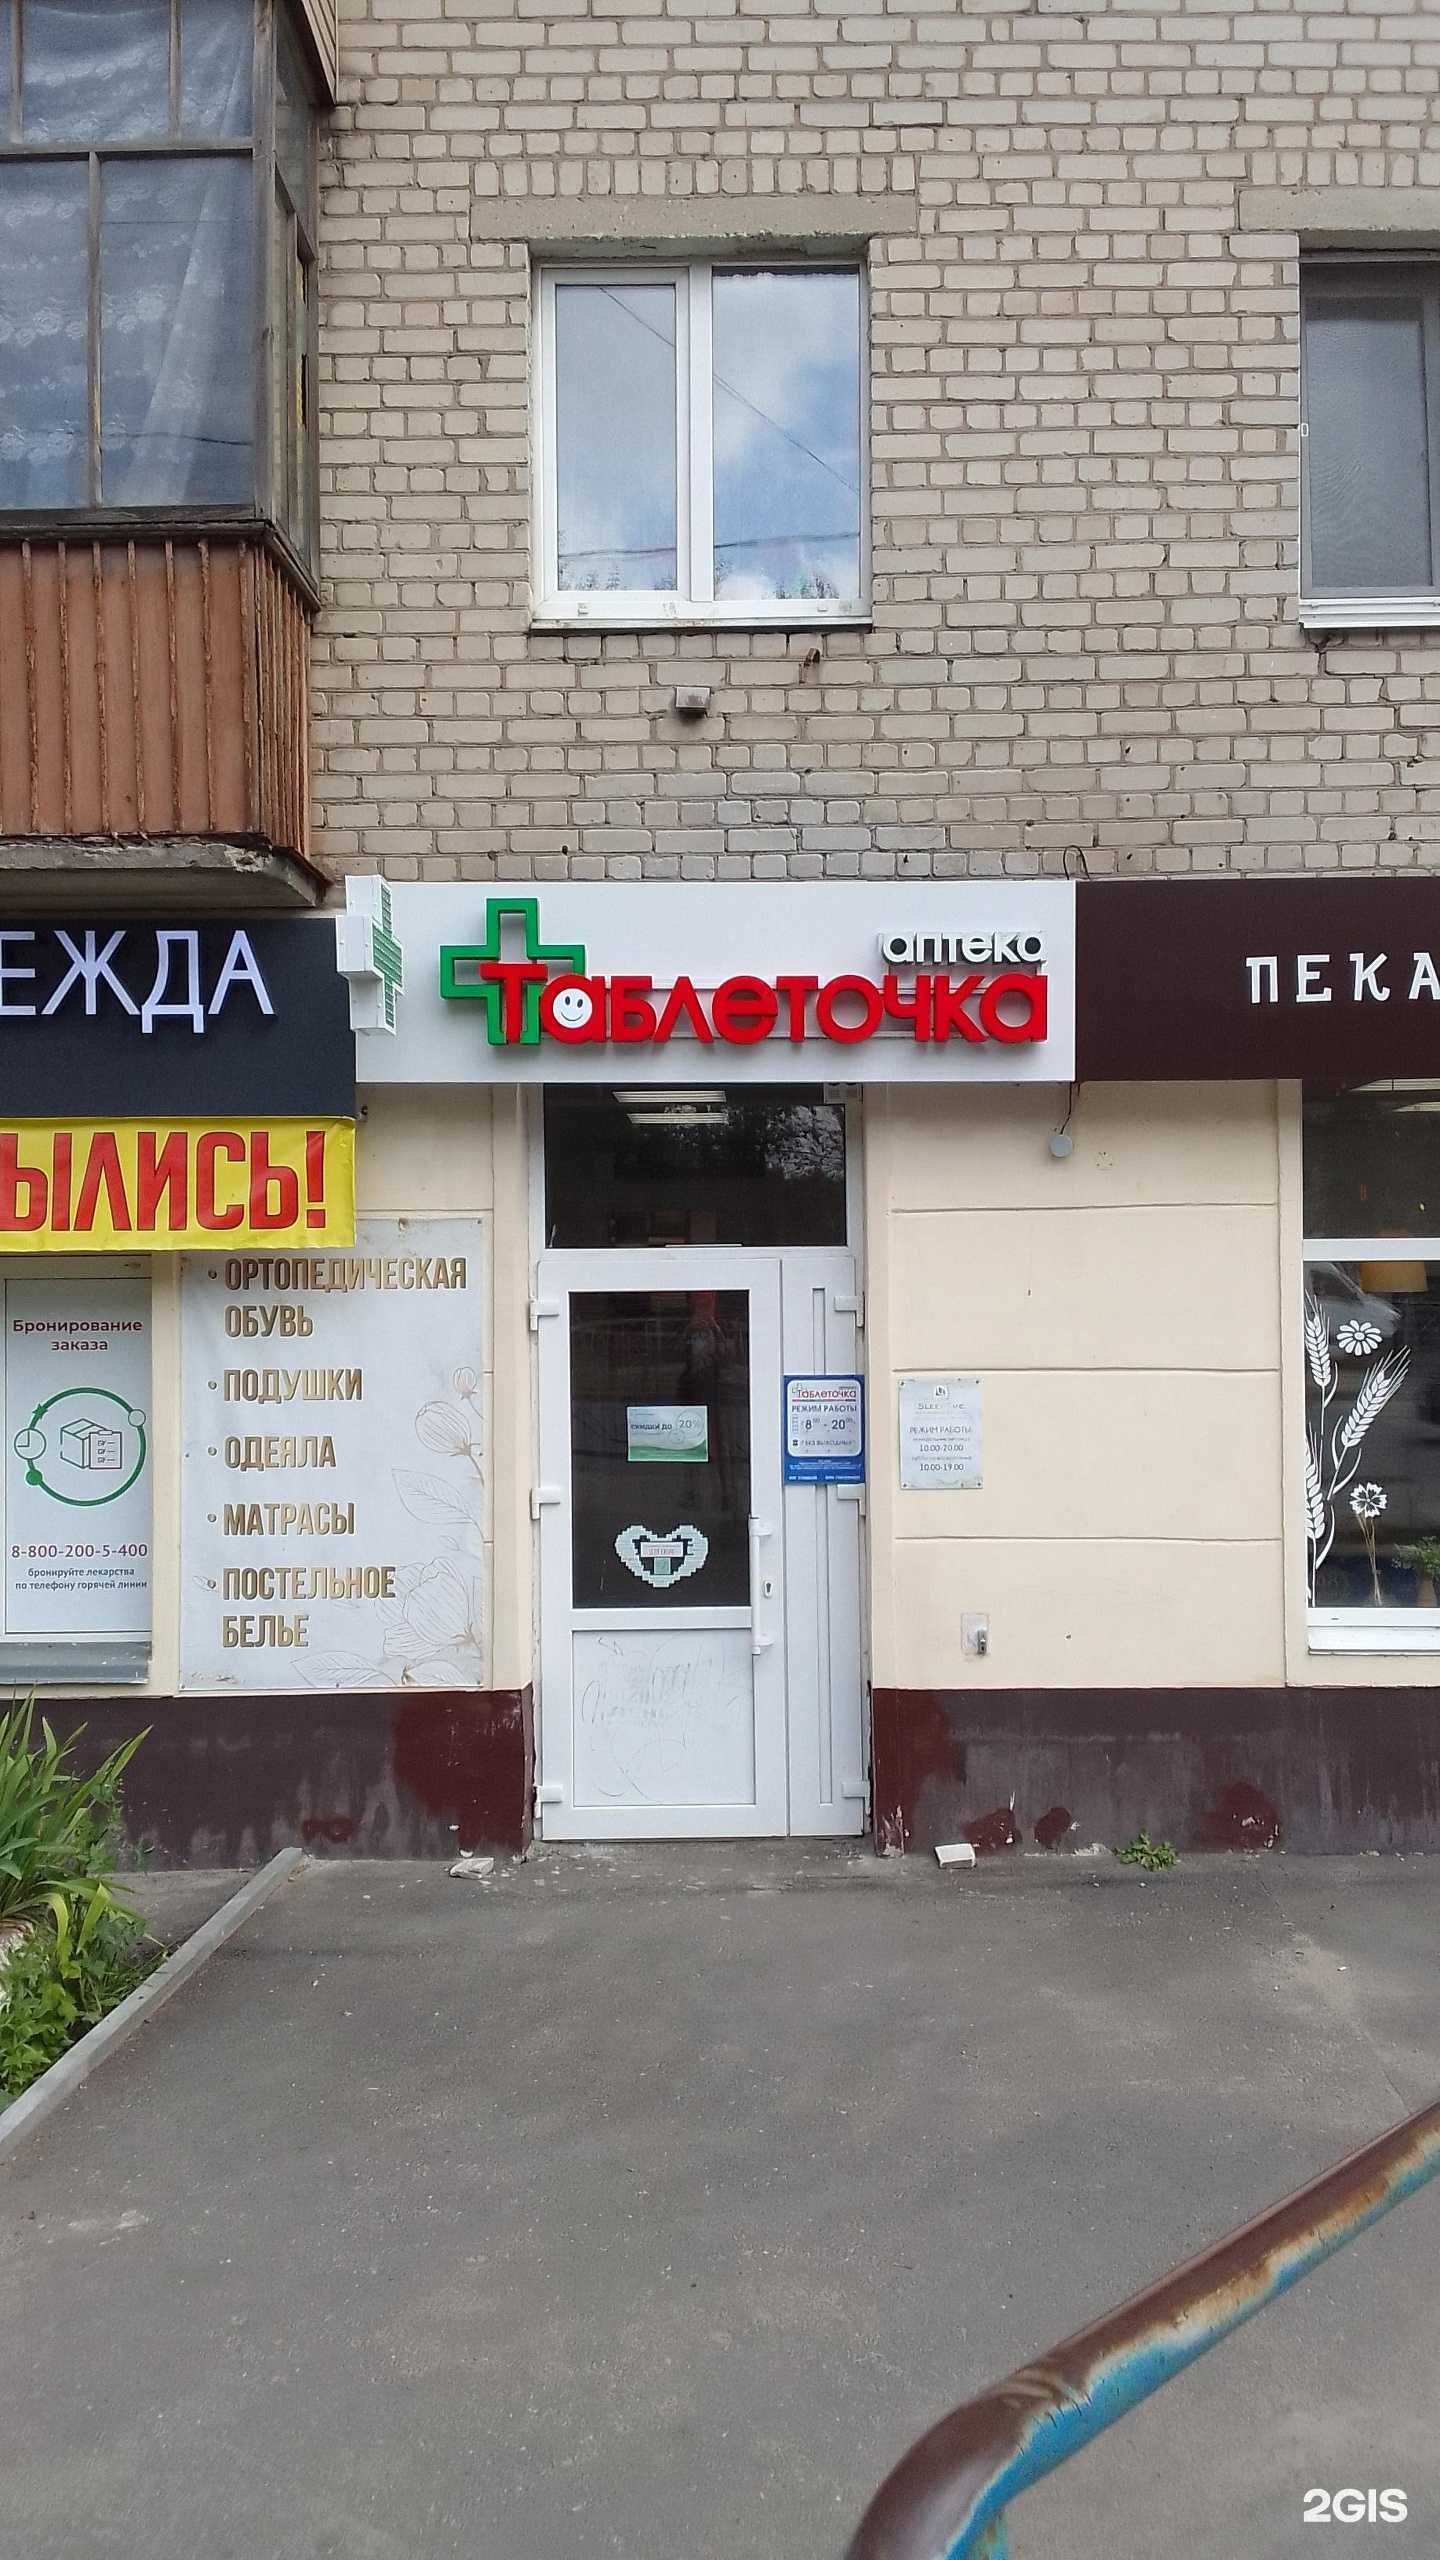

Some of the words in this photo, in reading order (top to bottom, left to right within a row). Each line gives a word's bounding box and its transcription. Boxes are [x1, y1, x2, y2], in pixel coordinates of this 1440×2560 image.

[882, 931, 1047, 963] аптека
[0, 930, 274, 1033] ЕЖДА
[1246, 952, 1440, 1004] ПЕКА
[480, 963, 1048, 1044] Таблеточка
[0, 1131, 326, 1231] ЫЛИСЬ!
[224, 1258, 467, 1293] ОРТОПЕДИЧЕСКАЯ
[13, 1320, 143, 1334] Бронирование
[224, 1305, 313, 1337] ОБУВЬ
[51, 1340, 108, 1351] заказа
[224, 1369, 362, 1404] ПОДУШКИ
[224, 1436, 336, 1471] ОДЕЯЛА
[223, 1503, 355, 1535] МАТРАСЫ
[11, 1544, 148, 1558] 8-800-200-5-400
[15, 1582, 27, 1590] по
[30, 1581, 75, 1591] телефону
[77, 1580, 116, 1590] горячей
[117, 1581, 147, 1589] линии
[28, 1567, 84, 1578] бронируйте
[86, 1568, 135, 1577] лекарства
[223, 1566, 396, 1600] ПОСТЕЛЬНОЕ
[222, 1615, 309, 1648] БЕЛЬЕ
